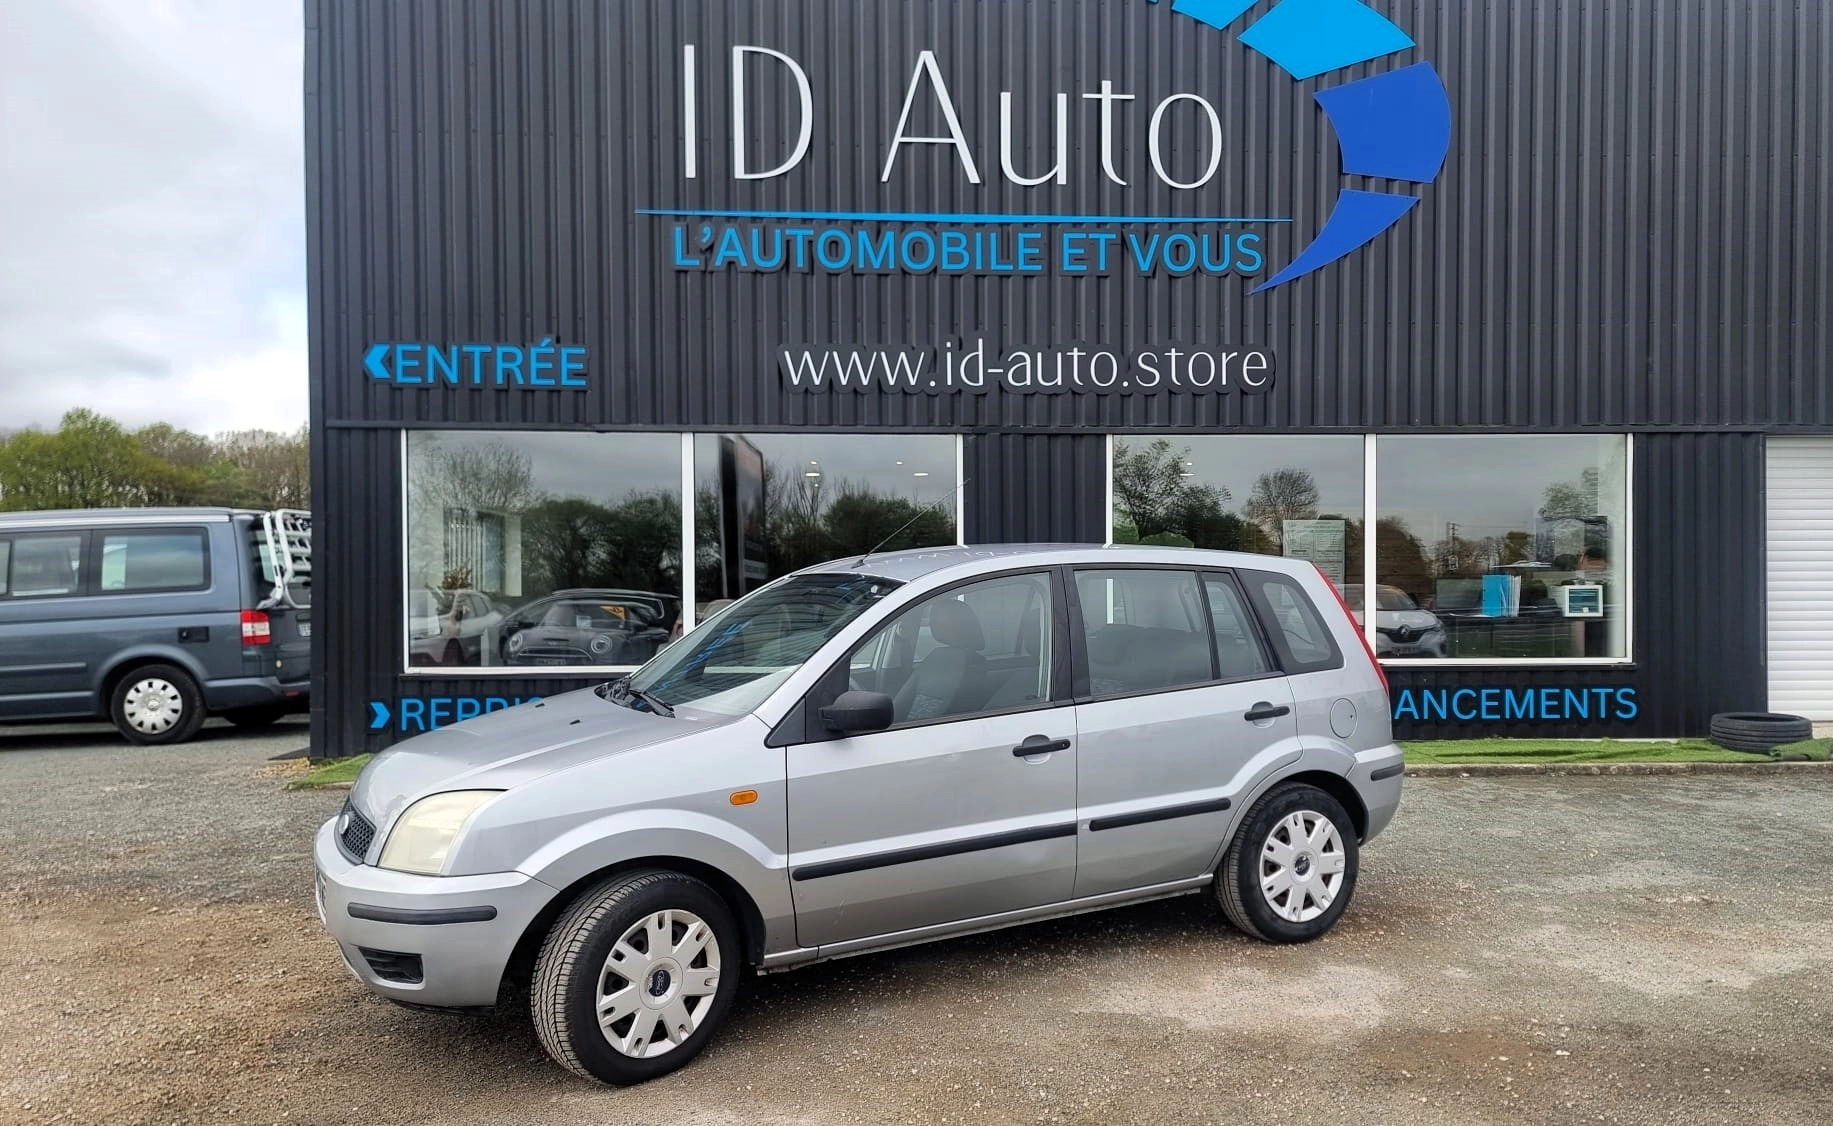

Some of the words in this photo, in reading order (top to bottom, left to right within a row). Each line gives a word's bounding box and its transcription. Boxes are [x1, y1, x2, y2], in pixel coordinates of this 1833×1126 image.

[683, 44, 813, 181] ID
[881, 50, 1223, 189] Auto
[1061, 231, 1117, 272] ET
[1128, 232, 1264, 273] VOUS
[395, 336, 587, 386] ENTRÉE
[784, 338, 1268, 388] www.id-auto.store
